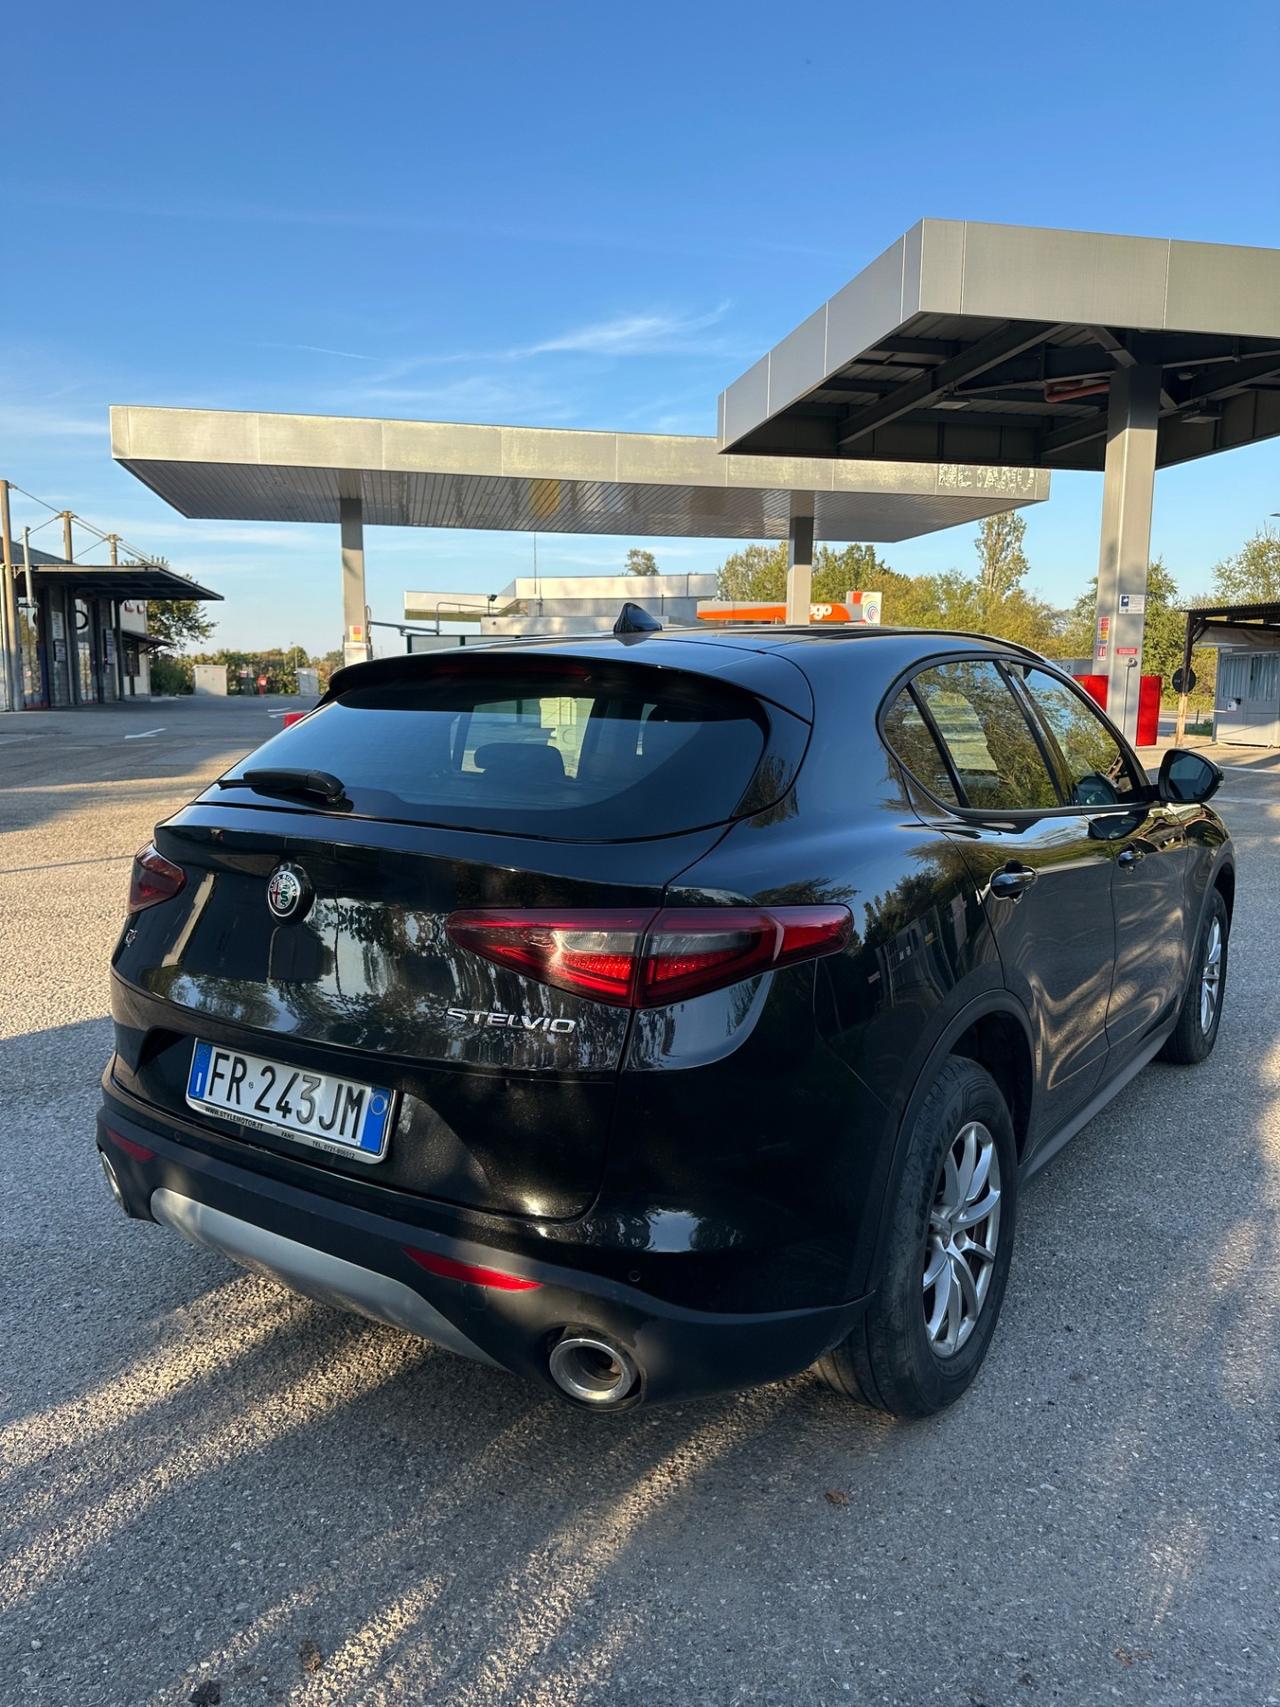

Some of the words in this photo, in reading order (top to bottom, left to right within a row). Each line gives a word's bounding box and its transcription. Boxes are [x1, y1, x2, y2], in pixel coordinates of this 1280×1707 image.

[447, 1007, 577, 1033] STELVIO
[208, 1051, 248, 1105] FR
[254, 1065, 366, 1139] 243JM
